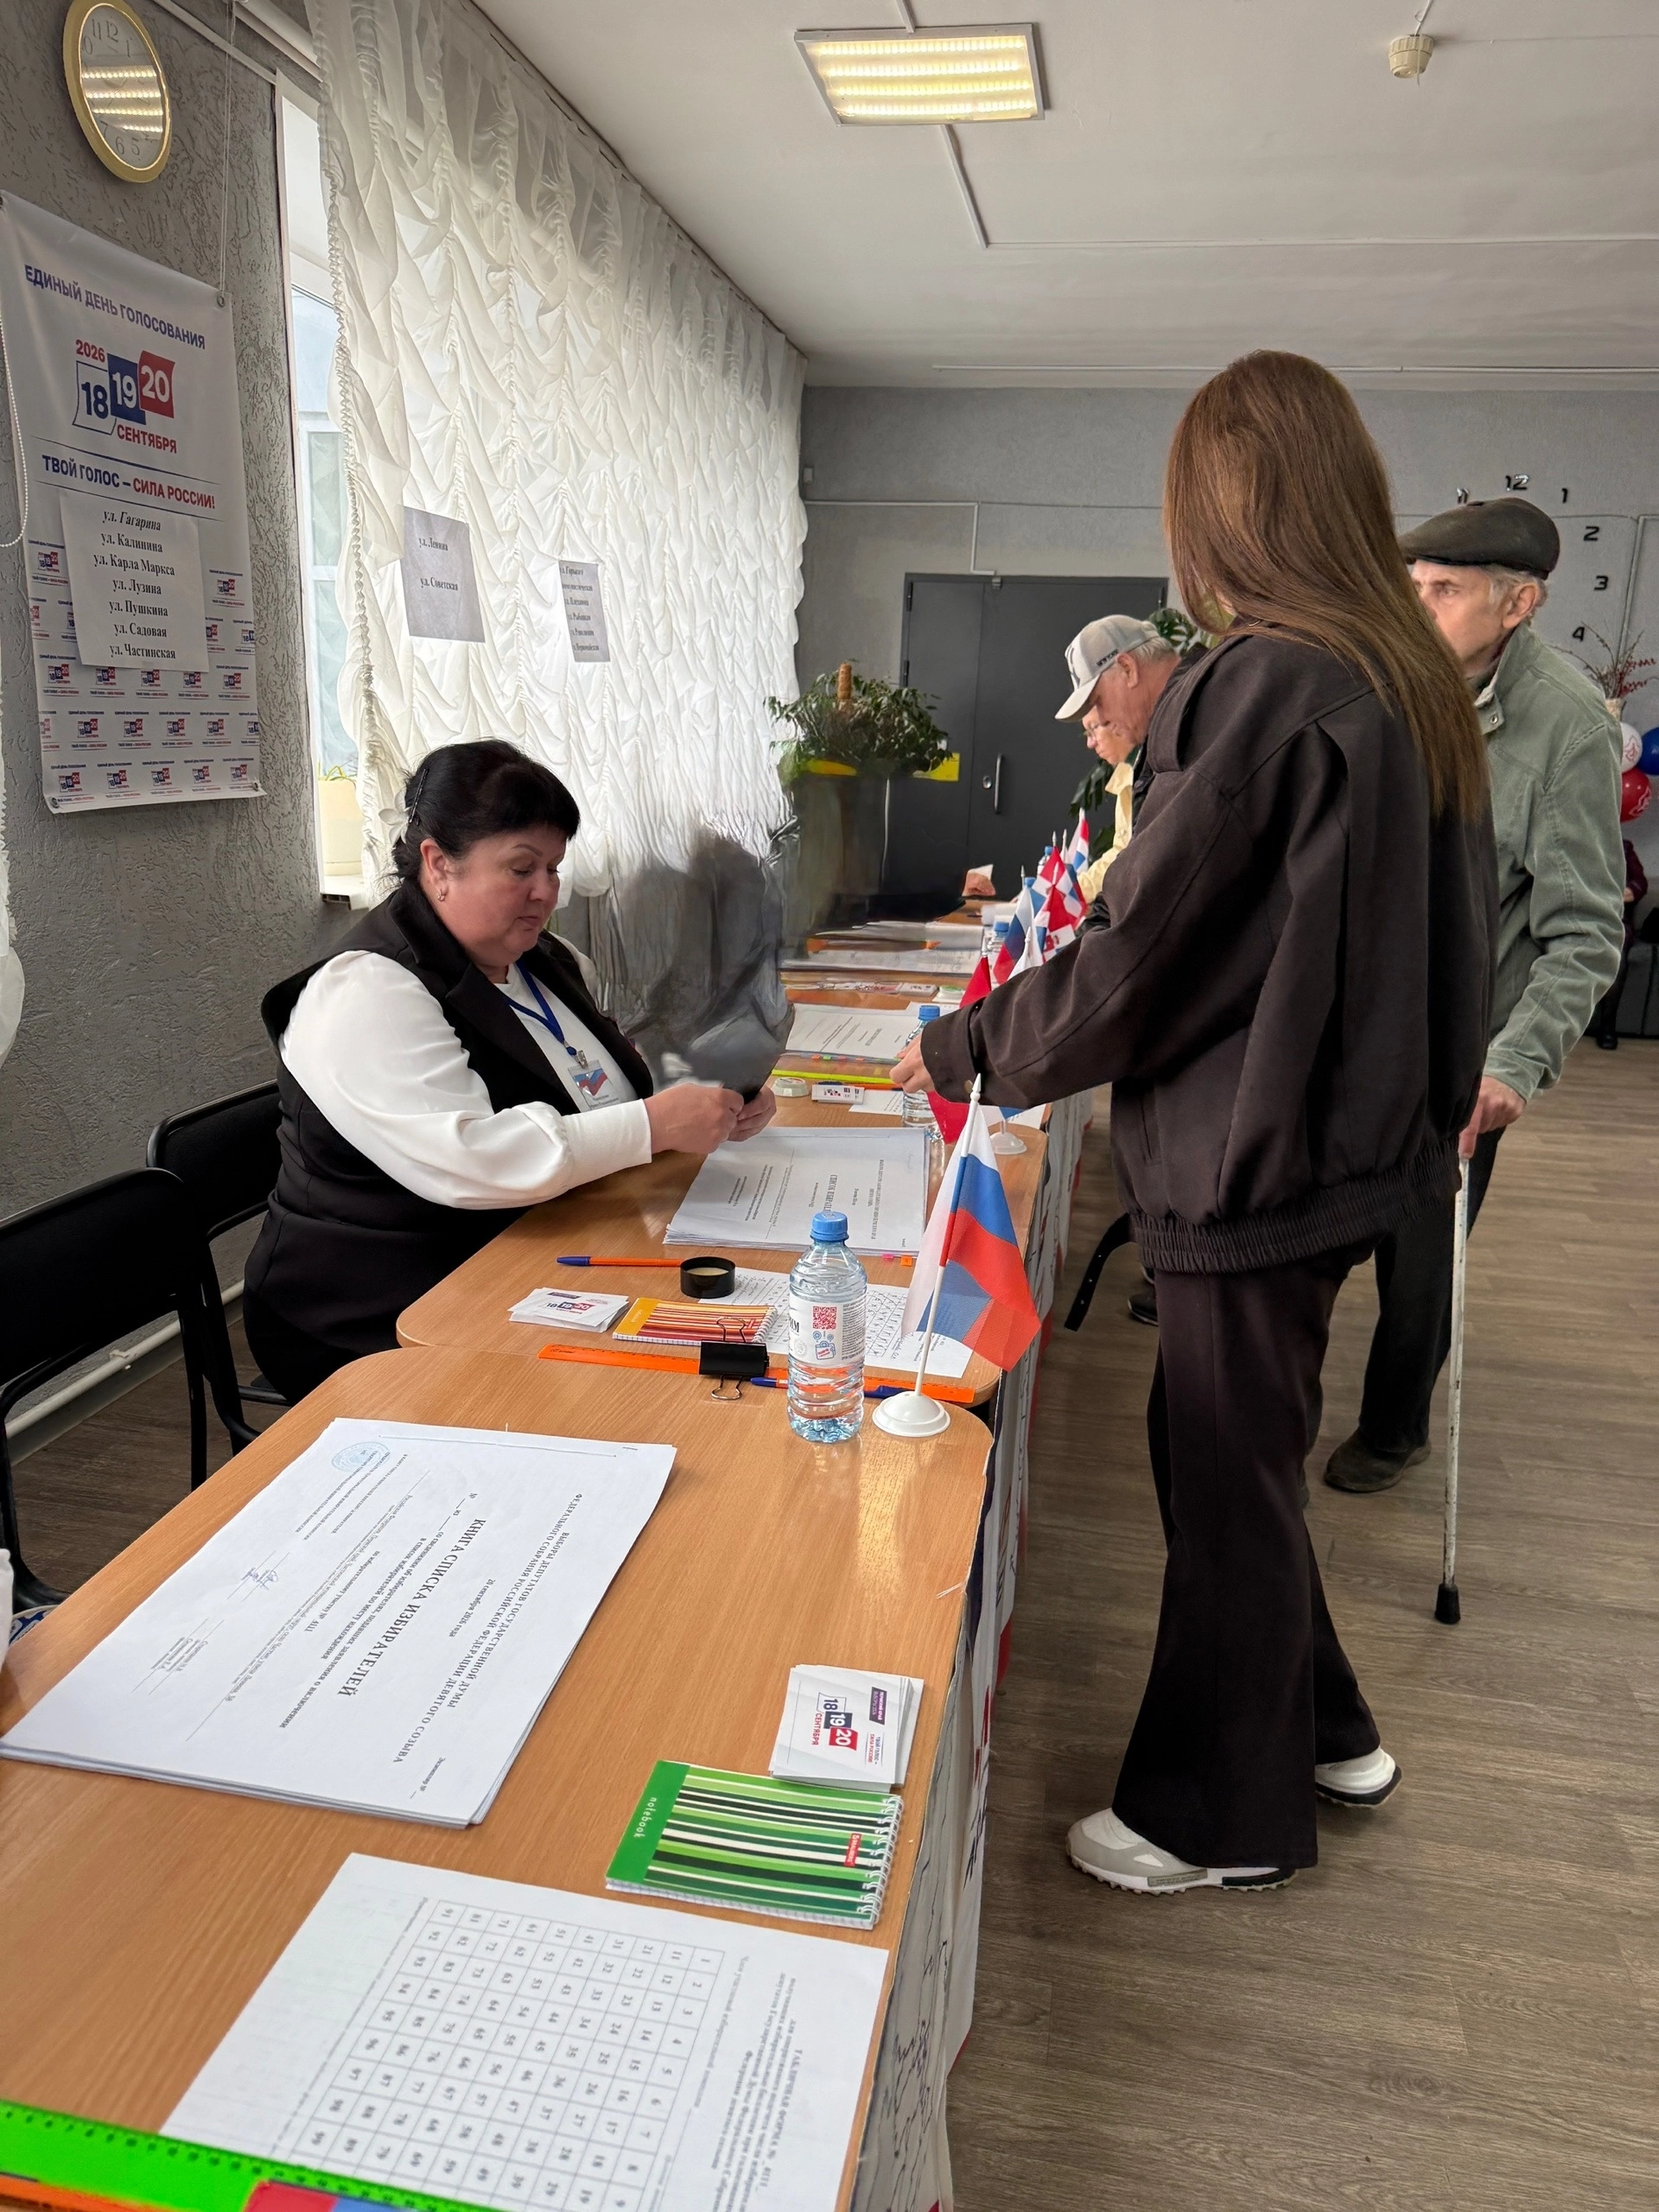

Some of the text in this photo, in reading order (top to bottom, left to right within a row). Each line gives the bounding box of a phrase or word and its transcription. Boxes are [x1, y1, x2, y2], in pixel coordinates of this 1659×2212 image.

[106, 21, 119, 42] 12
[115, 137, 125, 156] 6
[131, 137, 141, 156] 5
[24, 264, 206, 350] ЕДИНЫЙ ДЕНЬ ГОЛОСОВАНИЯ
[75, 339, 105, 363] 2026
[81, 365, 170, 421] 18 19 20
[117, 423, 177, 454] СЕНТЯБРЯ
[42, 454, 78, 478] ТВОЙ
[79, 464, 120, 489] ГОЛОС
[133, 478, 165, 499] СИЛА
[168, 487, 216, 510] РОССИИ!
[1505, 474, 1529, 492] 12
[1561, 488, 1569, 504] 1
[103, 512, 161, 531] ул. Гагарина
[101, 533, 162, 552] ул. Калинина
[1584, 526, 1599, 542] 2
[94, 554, 175, 576] ул. Карла Маркса
[113, 579, 161, 594] ул. Лузина
[1594, 575, 1609, 591] 3
[110, 601, 168, 616] ул. Пушкина
[114, 623, 167, 637] ул. Садовая
[1573, 626, 1586, 641] 4
[110, 644, 175, 658] ул. Частинская
[404, 1542, 423, 1559] список
[410, 1539, 438, 1568] сведениями
[375, 1560, 407, 1595] избирателей
[367, 1595, 378, 1605] по
[372, 1576, 407, 1613] избирателях,
[468, 1586, 489, 1611] сентября
[338, 1519, 486, 1696] КНИГА СПИСКА ИЗБИРАТЕЛЕЙ
[353, 1605, 371, 1620] месту
[448, 1533, 569, 1707] ВЫБОРЫ ДЕПУТАТОВ ГОСУДАРСТВЕННОЙ ДУМЫ
[459, 1611, 474, 1624] 2026
[346, 1615, 376, 1644] подавших
[393, 1494, 582, 1762] ФЕДЕРАЛЬНОГО СОБРАНИЯ РОССИЙСКОЙ ФЕДЕРАЦИИ ДЕВЯТОГО СОЗЫВА
[449, 1624, 462, 1637] года
[321, 1621, 356, 1659] нахождения
[318, 1646, 350, 1680] заявления
[279, 1688, 316, 1728] включении
[811, 1713, 823, 1745] СЕНТЯБРЯ
[823, 1699, 852, 1745] 18 19 20
[633, 1796, 658, 1838] notebook
[641, 1944, 654, 1955] 21
[671, 1950, 683, 1961] 11
[632, 1967, 644, 1979] 22
[661, 1974, 673, 1985] 12
[620, 1994, 633, 2007] 23
[651, 2000, 664, 2012] 13
[597, 2051, 611, 2065] 25
[628, 2058, 641, 2071] 15
[662, 2067, 672, 2075] 5
